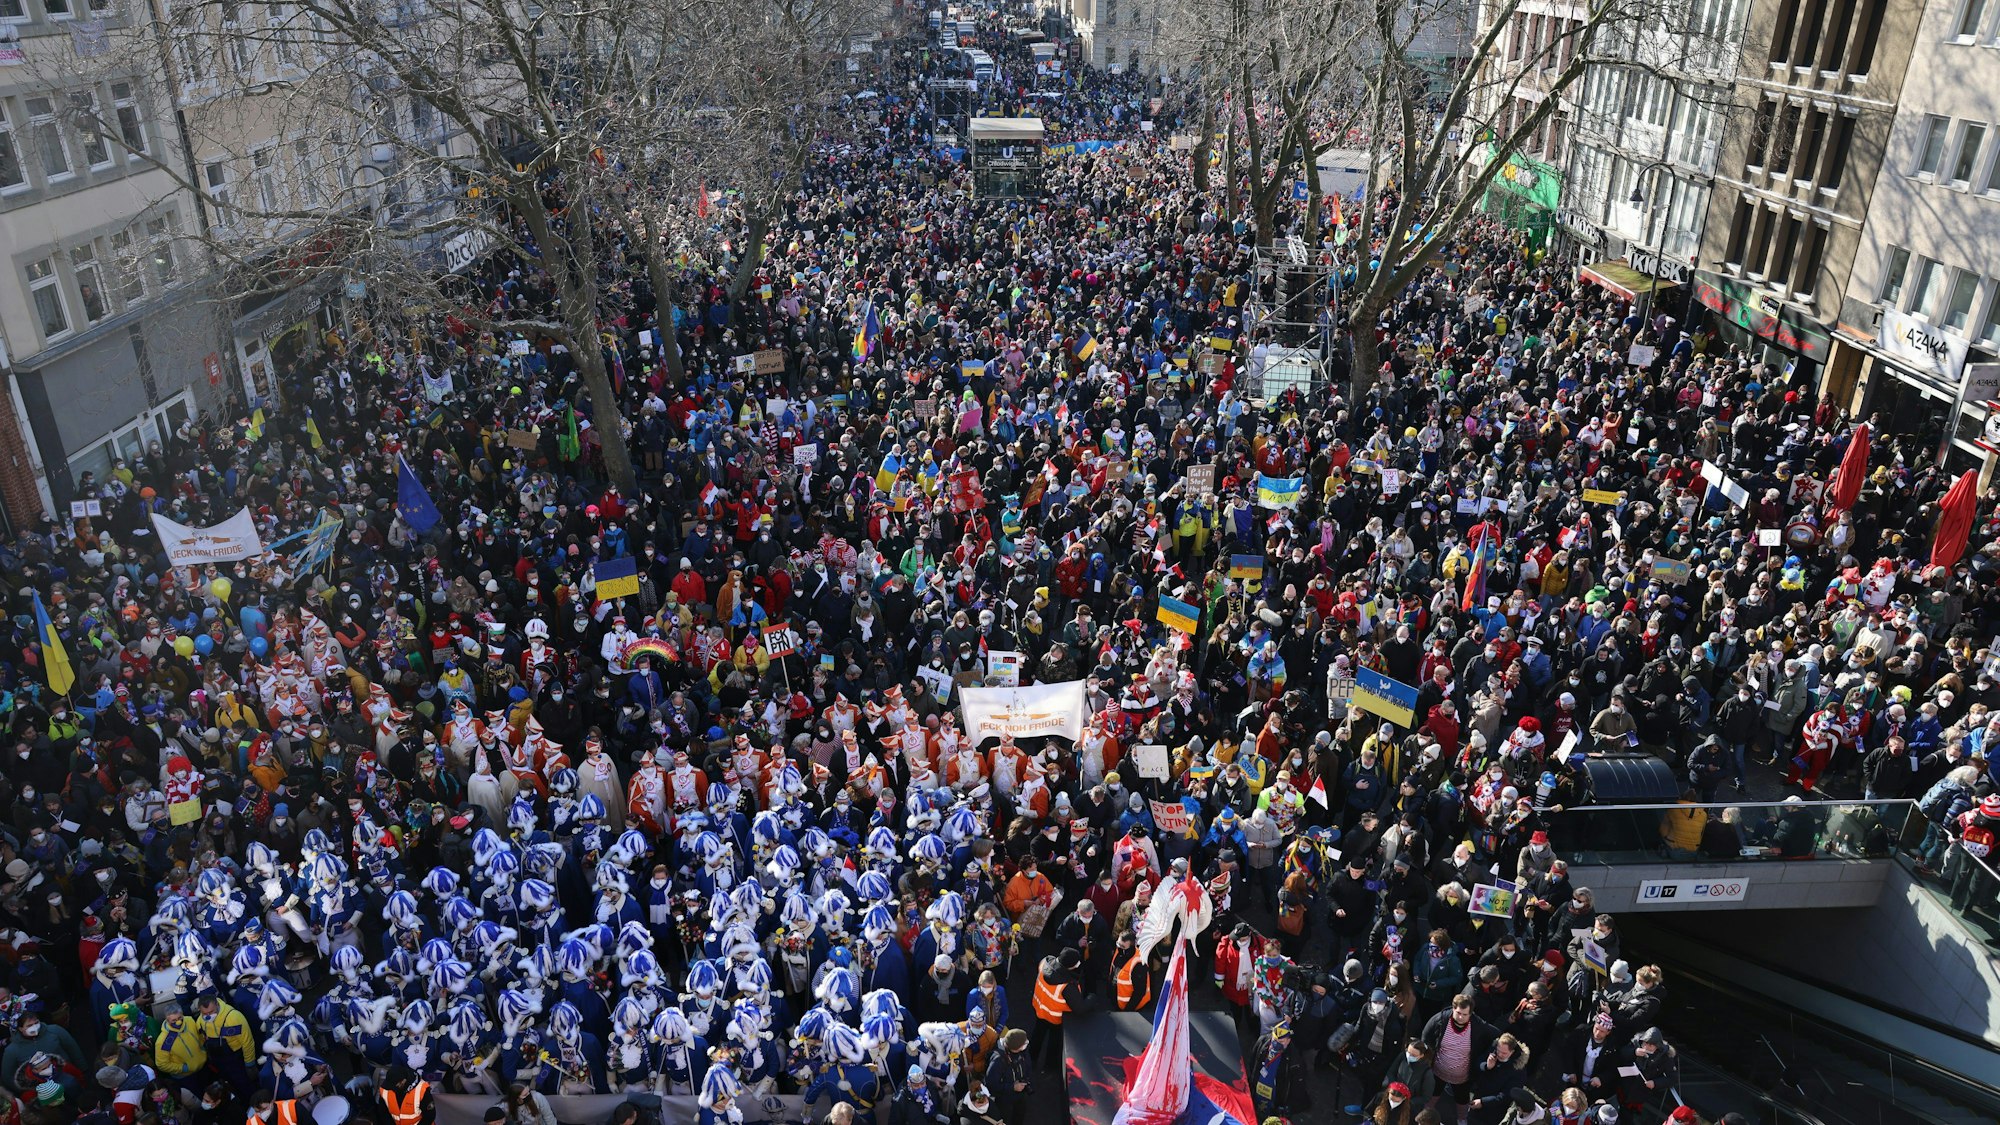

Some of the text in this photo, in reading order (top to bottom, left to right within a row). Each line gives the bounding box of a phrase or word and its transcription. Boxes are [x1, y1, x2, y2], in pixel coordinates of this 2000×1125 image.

[1448, 131, 1455, 140] U
[1002, 147, 1013, 159] U
[1051, 144, 1075, 158] WAR
[1632, 253, 1683, 282] KIOSK
[1760, 300, 1777, 316] Pizza
[1757, 316, 1817, 352] Döner
[771, 362, 782, 370] WAR
[1190, 468, 1211, 477] Putin
[171, 544, 243, 559] JECK NOH FRIDDE
[768, 627, 790, 644] FCK
[770, 640, 791, 653] PTN
[979, 717, 1065, 732] JECK NOH FRIDDE
[1241, 760, 1258, 778] STOP
[1152, 803, 1183, 814] STOP
[1154, 813, 1187, 828] PUTIN
[1646, 886, 1674, 898] U 17
[1489, 898, 1507, 906] NOT
